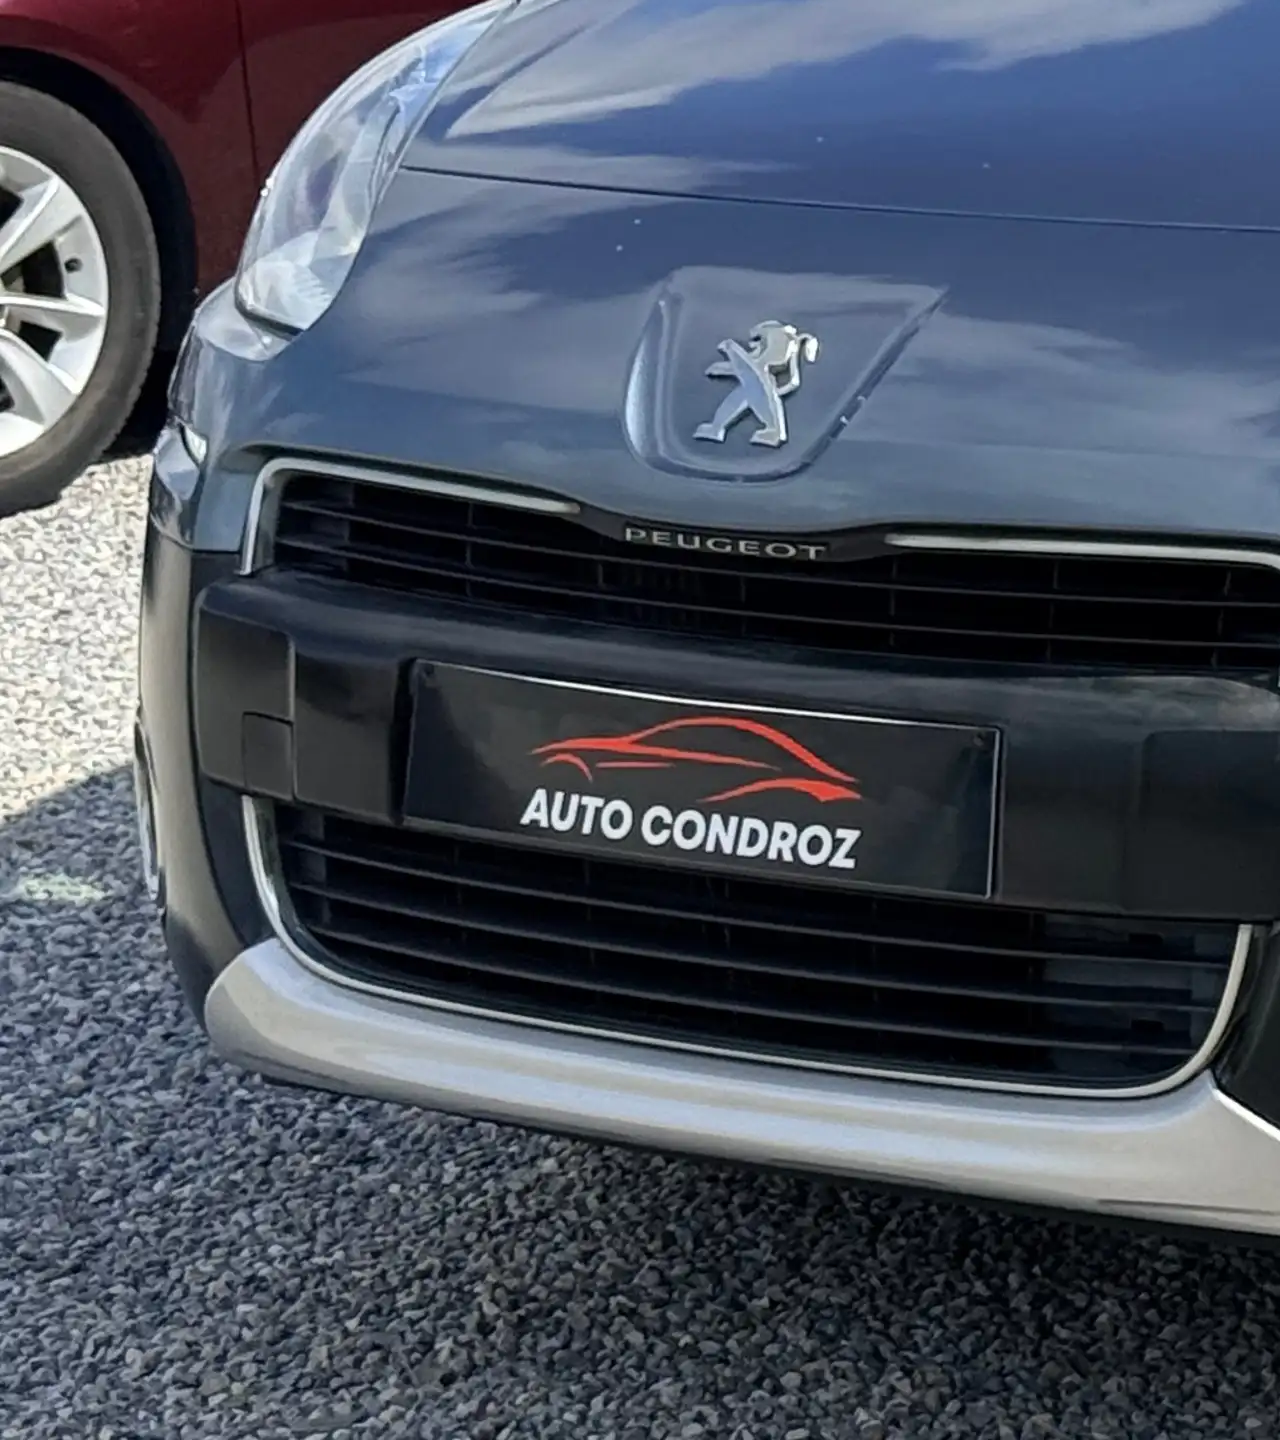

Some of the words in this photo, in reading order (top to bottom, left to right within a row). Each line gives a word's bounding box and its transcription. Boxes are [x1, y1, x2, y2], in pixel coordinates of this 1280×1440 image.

[624, 526, 826, 561] PEUGEOT
[519, 787, 633, 842] AUTO
[640, 804, 863, 870] CONDROZ
